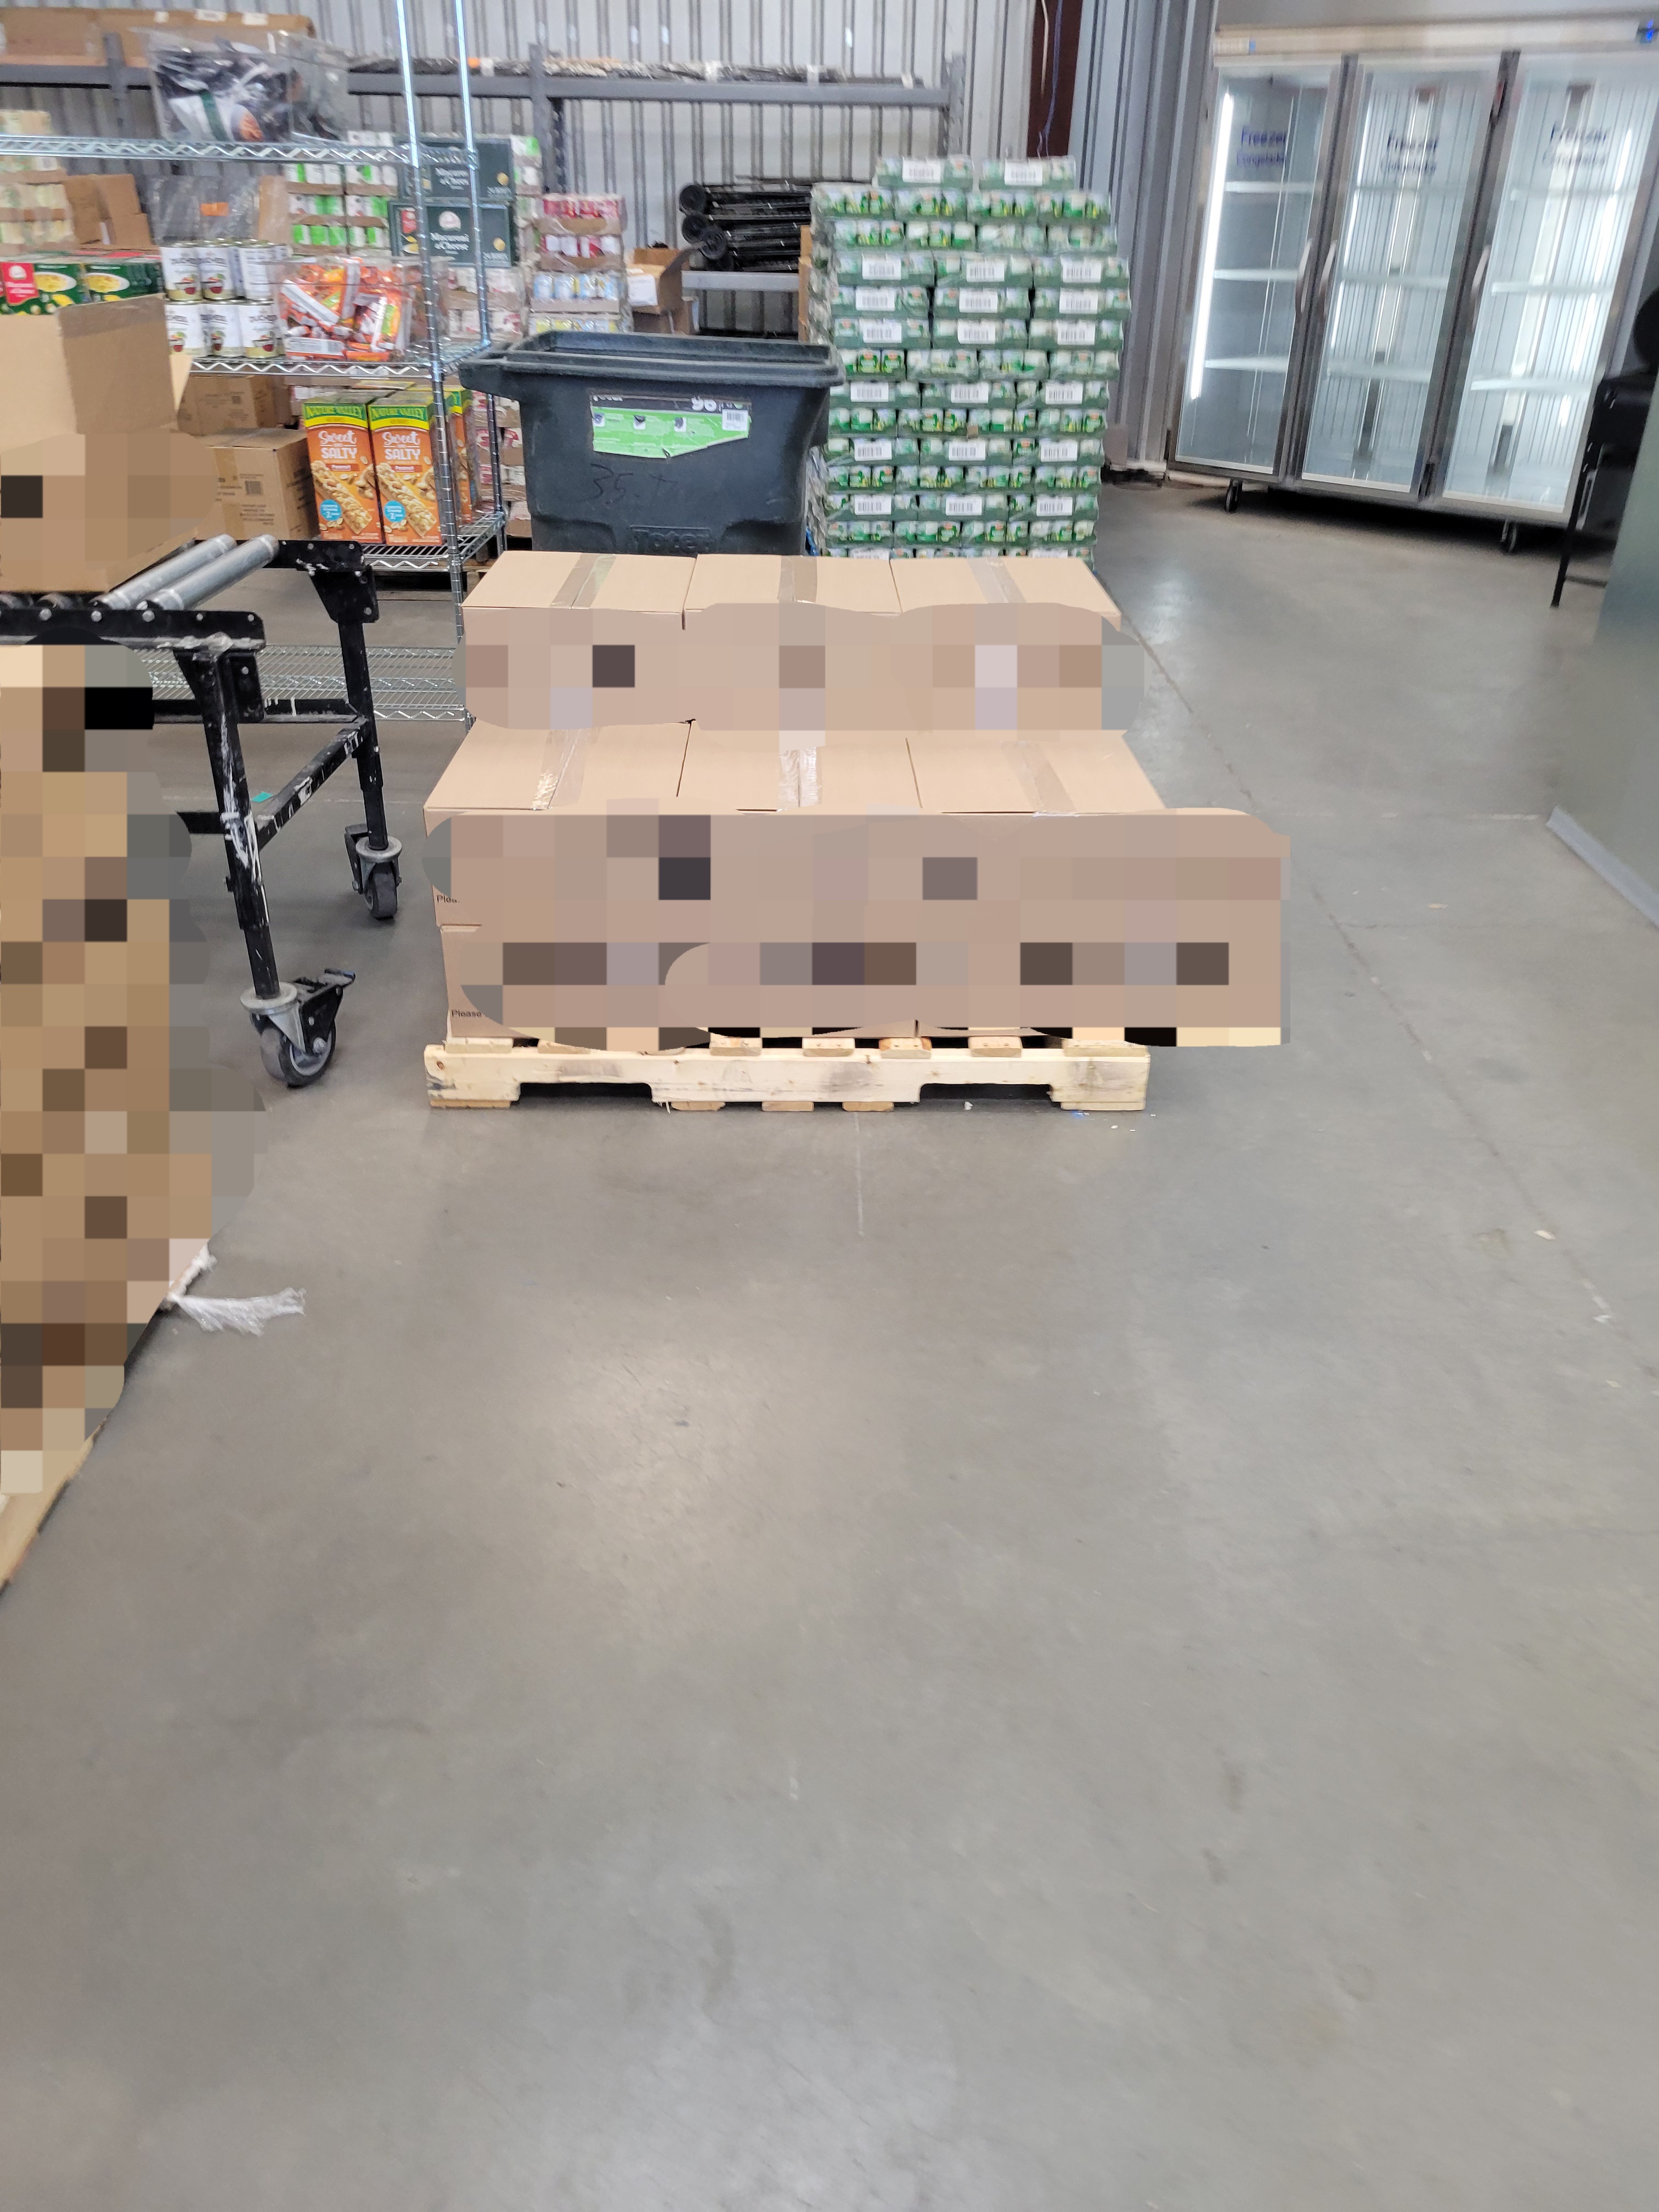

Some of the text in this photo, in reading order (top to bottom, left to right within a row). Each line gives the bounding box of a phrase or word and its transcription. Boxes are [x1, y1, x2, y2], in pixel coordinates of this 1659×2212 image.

[1241, 126, 1286, 146] Freezer
[318, 430, 357, 445] Sweet
[382, 431, 421, 446] Sweet
[320, 447, 357, 459] SALTY
[385, 448, 421, 460] SALTY
